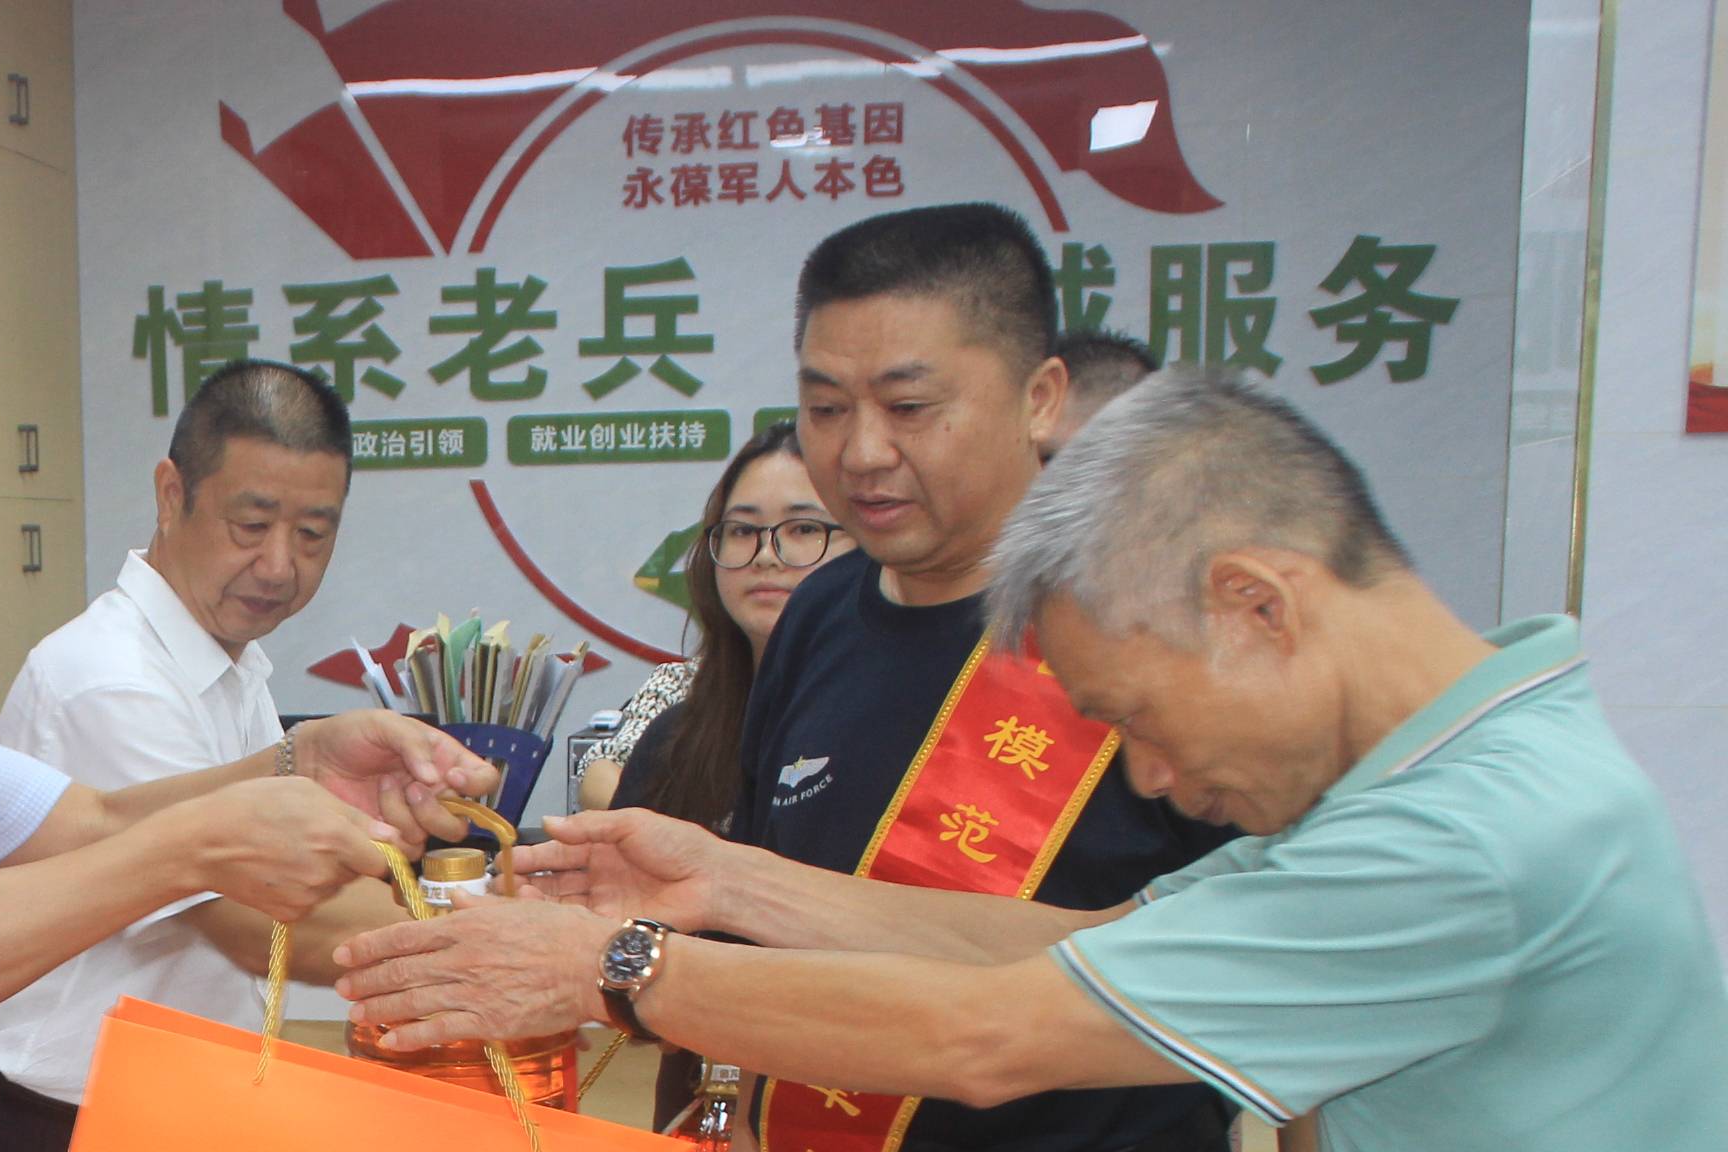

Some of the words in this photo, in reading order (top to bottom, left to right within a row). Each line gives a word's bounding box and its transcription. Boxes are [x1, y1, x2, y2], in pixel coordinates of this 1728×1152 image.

[622, 102, 904, 158] 传承红色基因
[622, 154, 905, 208] 永葆军人本色
[133, 256, 715, 418] 情系老兵
[352, 428, 465, 458] 政治引领
[530, 422, 707, 453] 就业创业扶持
[782, 794, 798, 806] AIR
[800, 774, 834, 800] FORCE
